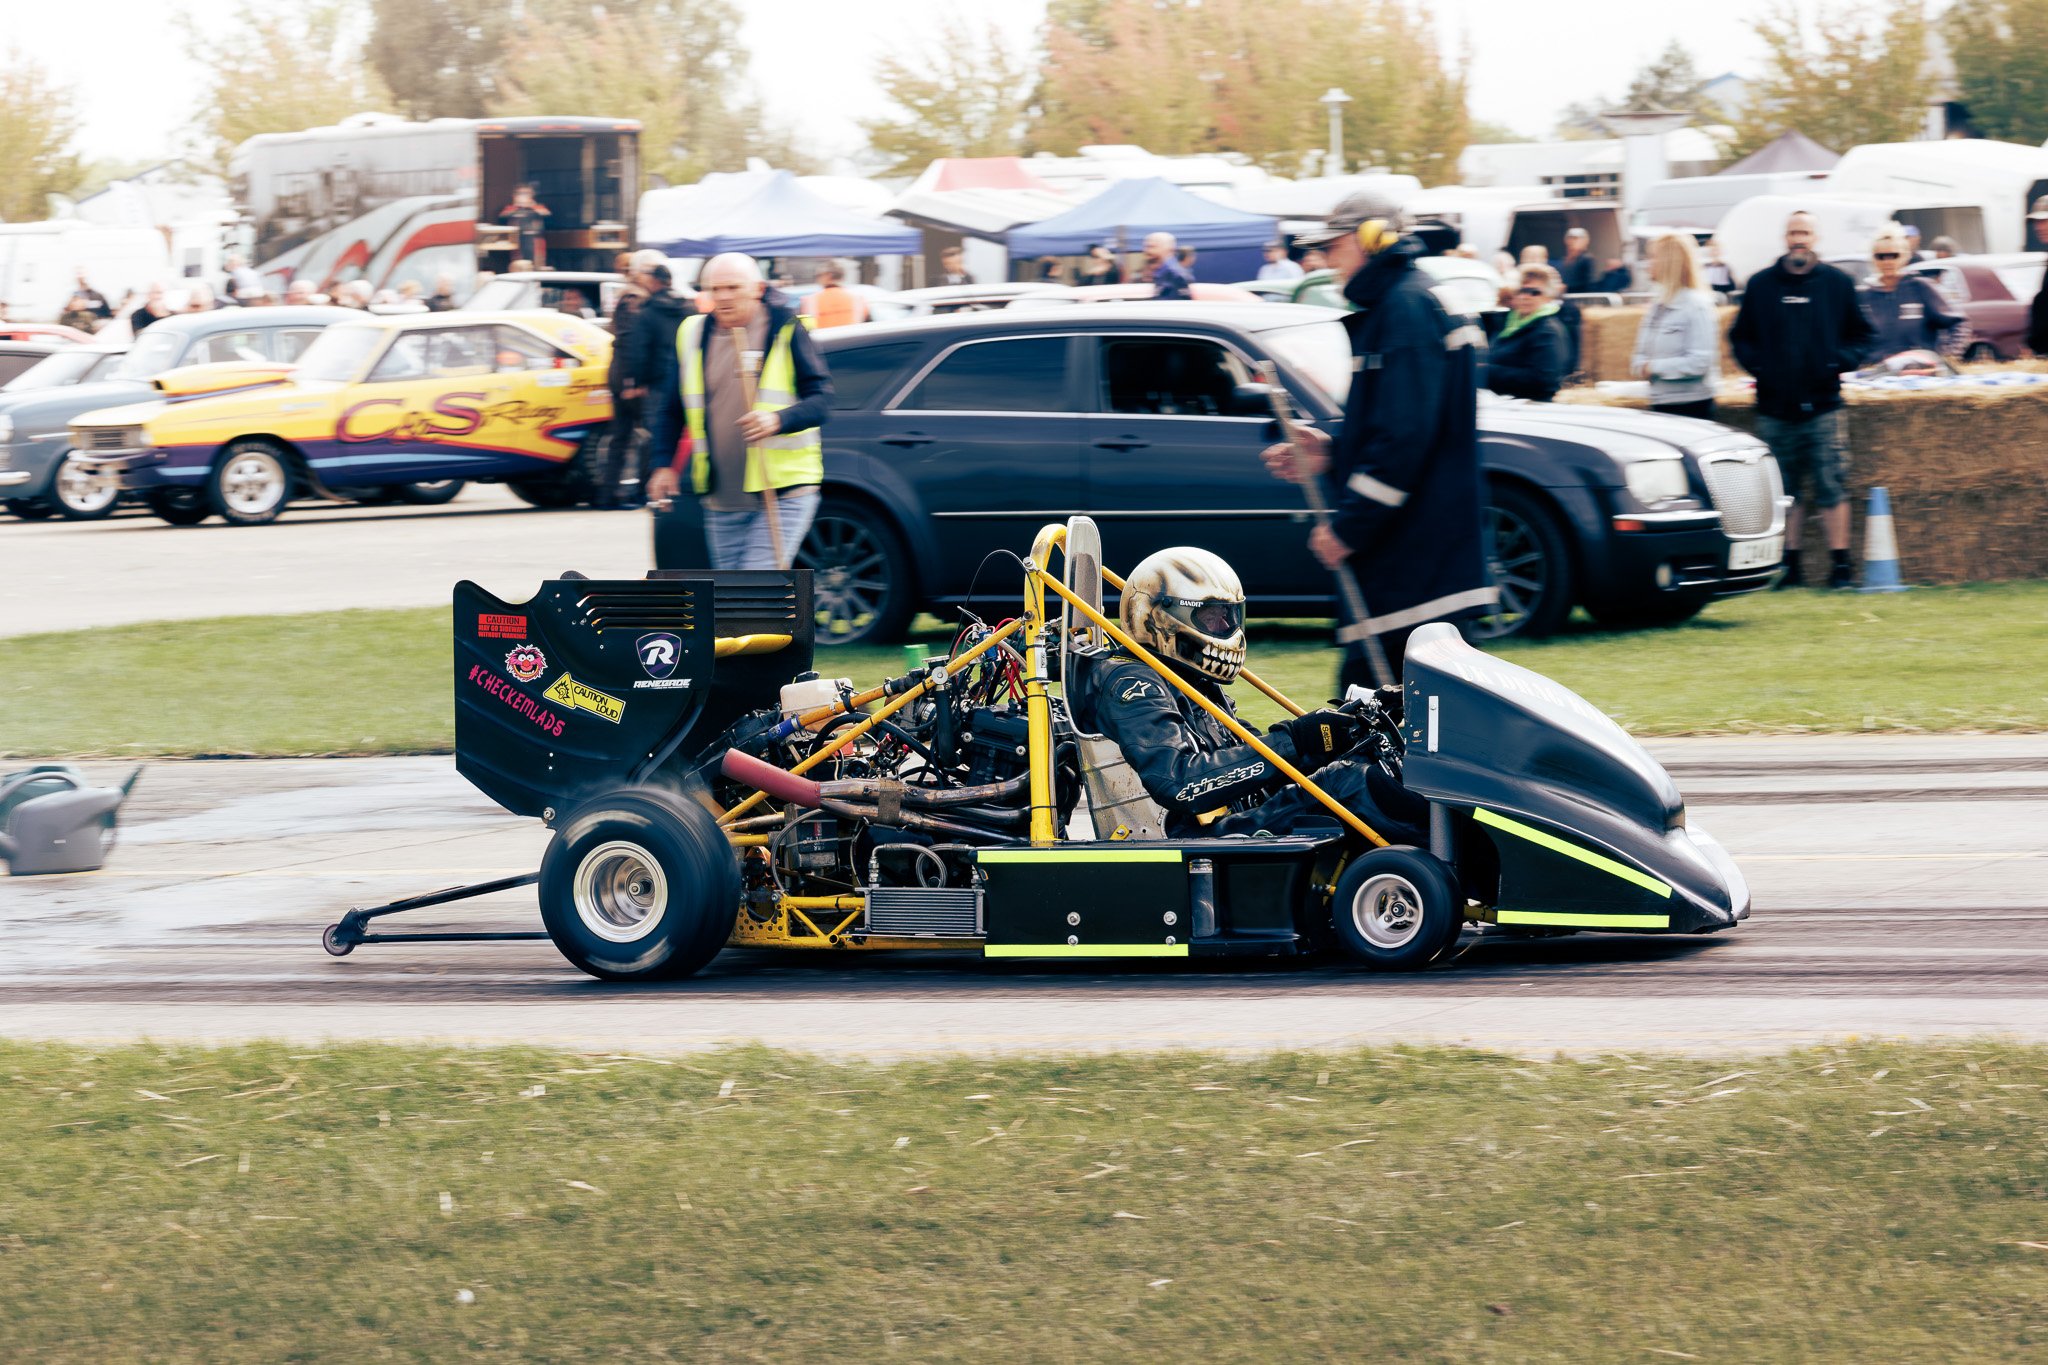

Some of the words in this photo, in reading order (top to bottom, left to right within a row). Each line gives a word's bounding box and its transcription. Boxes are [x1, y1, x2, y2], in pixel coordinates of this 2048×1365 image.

[1179, 599, 1202, 608] BANDIT
[486, 615, 520, 625] CAUTION
[633, 679, 692, 689] RENEGADE
[468, 664, 566, 737] #CHECKEMLADS
[573, 685, 609, 706] CAUTION
[595, 704, 619, 719] LOUD
[1175, 761, 1265, 802] alpinestars
